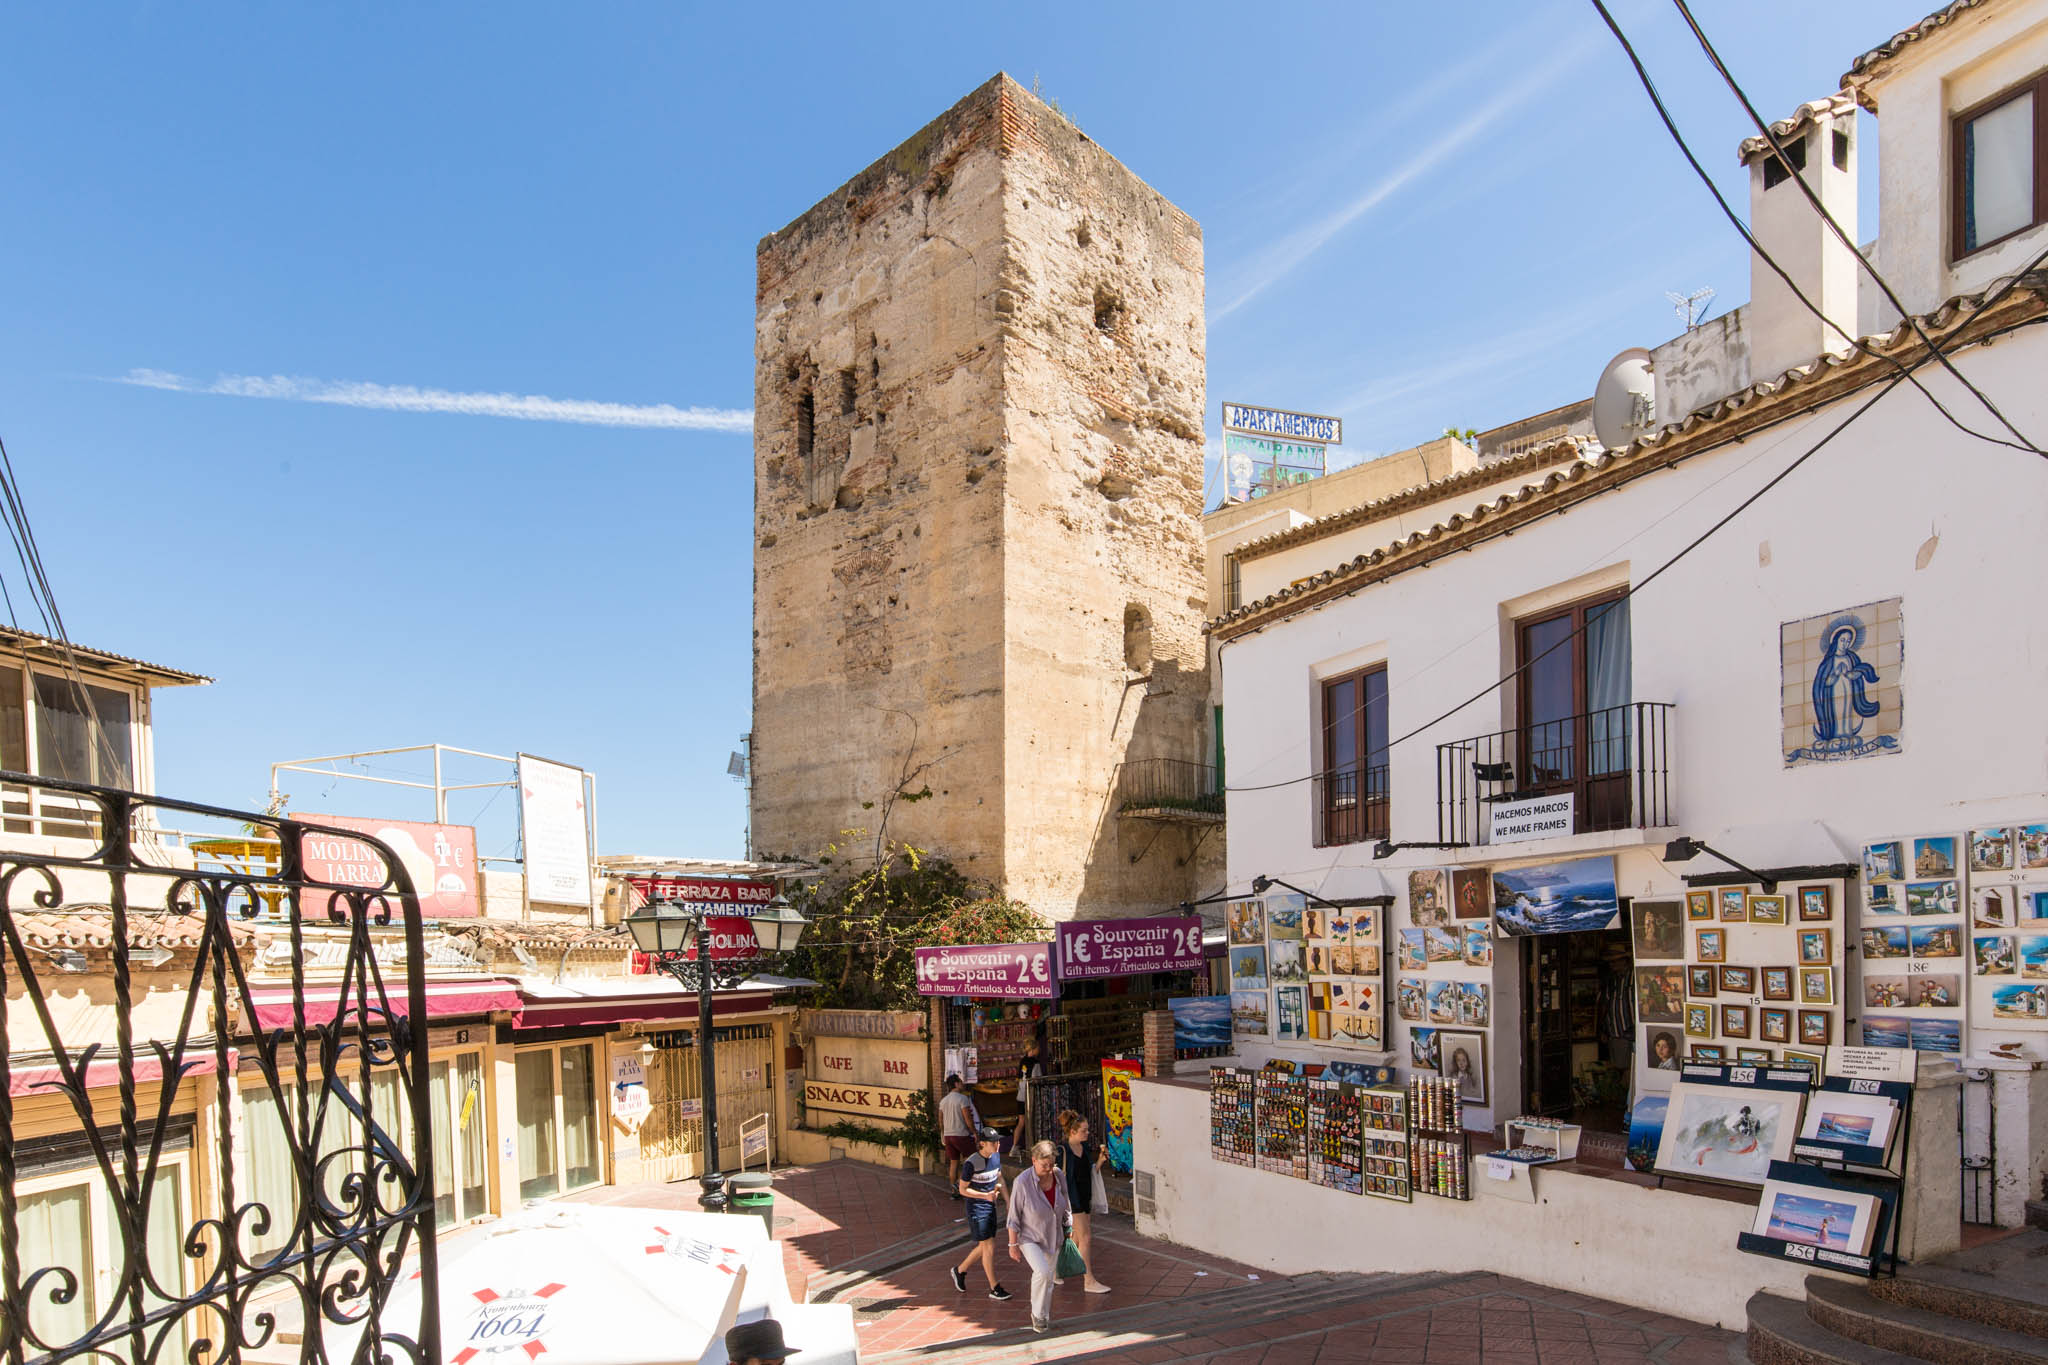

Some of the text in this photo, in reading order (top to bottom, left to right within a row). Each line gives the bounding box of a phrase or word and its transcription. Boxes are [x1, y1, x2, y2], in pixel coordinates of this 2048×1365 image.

[1233, 406, 1332, 439] APARTAMENTOS
[1495, 801, 1569, 820] HACEMOS MARCOS
[1496, 819, 1567, 836] WE MAKE FRAMES
[327, 864, 383, 883] JARRA
[655, 884, 731, 900] TERRAZA
[1065, 925, 1201, 963] 1€ Souvenir 2€
[1101, 943, 1165, 962] España
[917, 950, 1048, 983] 1€ Souvenir 2€
[947, 967, 1008, 983] España
[1066, 966, 1082, 976] Gift
[1085, 965, 1110, 974] items
[1162, 960, 1173, 968] de
[1175, 958, 1202, 968] regalo
[919, 984, 932, 992] Gift
[934, 984, 955, 992] items
[1005, 985, 1016, 993] de
[1019, 985, 1051, 996] regalo
[1749, 997, 1761, 1005] 15
[809, 1014, 895, 1034] APARTAMENTOS
[824, 1056, 910, 1076] CAFE BAR
[1731, 1070, 1755, 1081] 45€
[806, 1086, 871, 1107] SNACK
[1786, 1243, 1815, 1259] 25€
[468, 1311, 546, 1341] 1664
